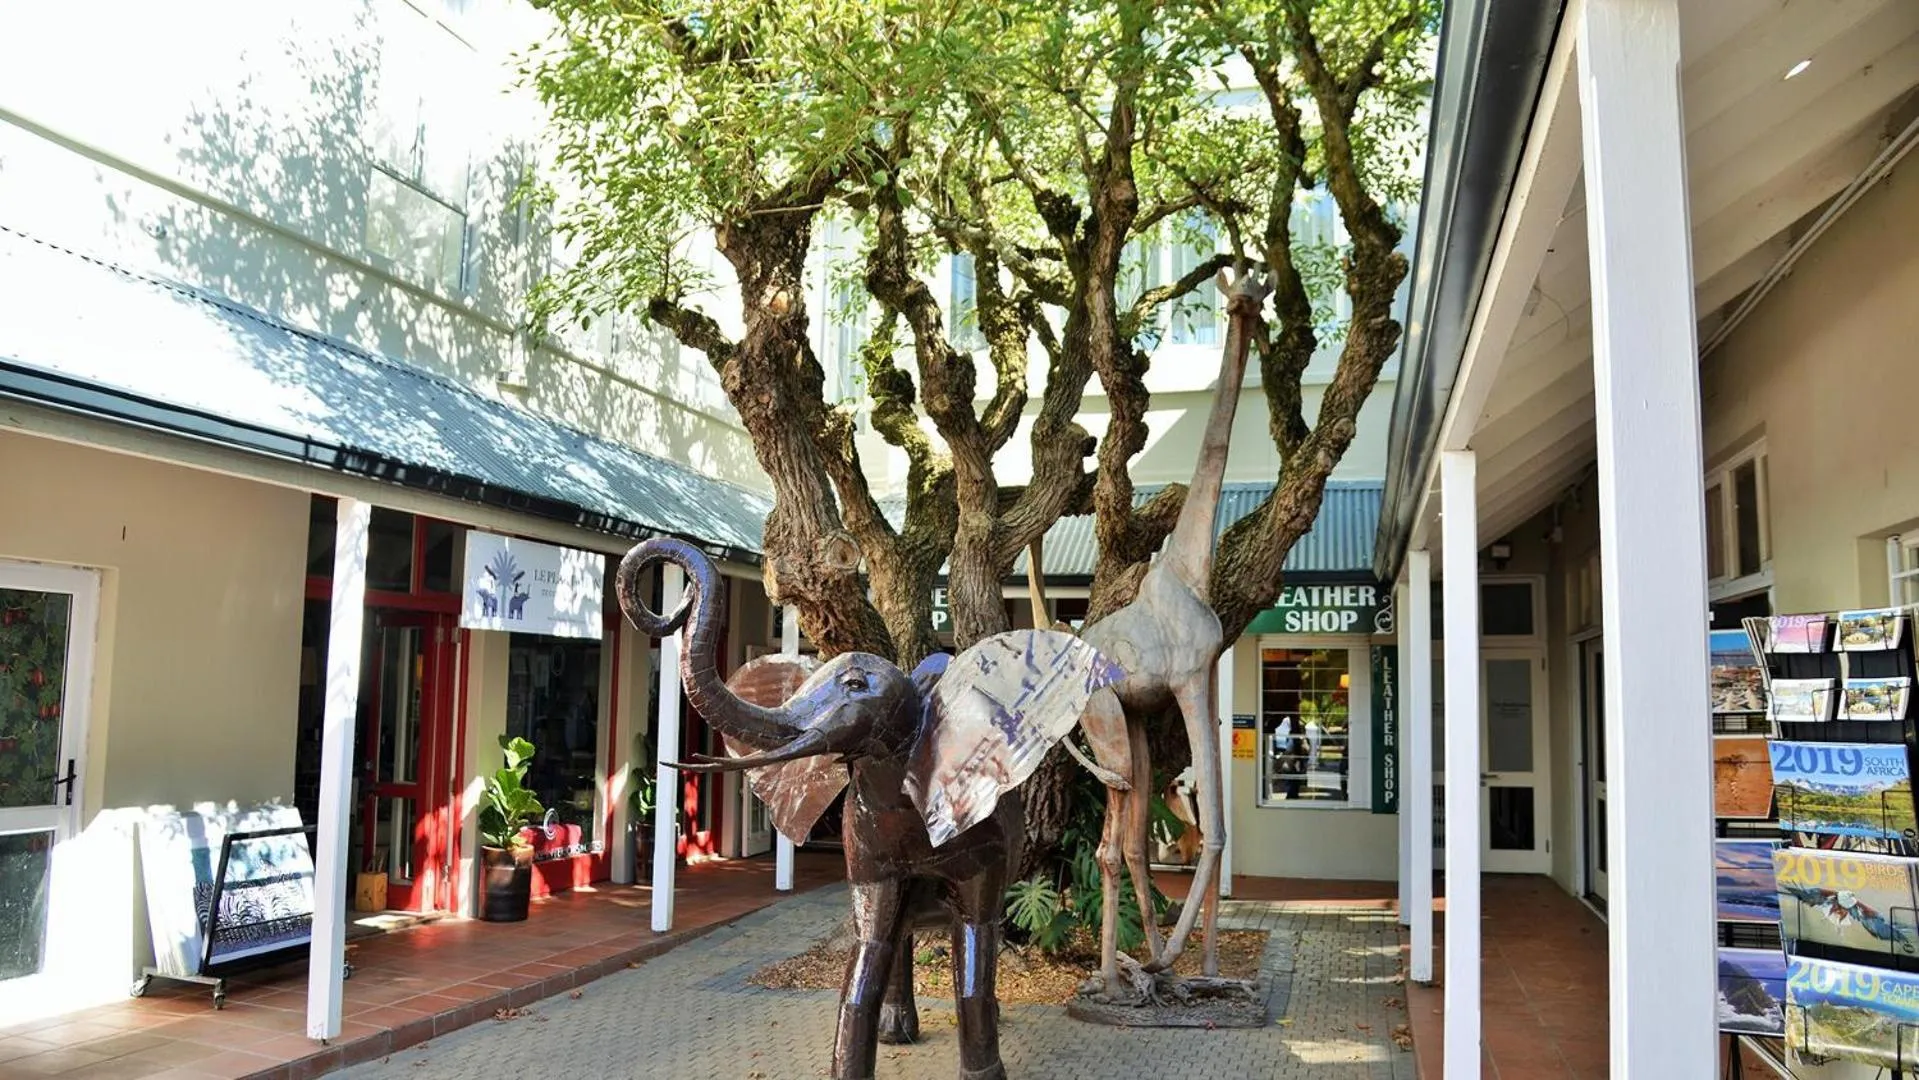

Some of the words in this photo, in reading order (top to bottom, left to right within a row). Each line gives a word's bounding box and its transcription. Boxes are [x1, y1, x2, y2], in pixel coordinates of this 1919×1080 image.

[1274, 585, 1377, 607] EATHER
[1285, 610, 1358, 632] SHOP
[1383, 656, 1395, 746] LEATHER
[1772, 745, 1863, 776] 2019
[1864, 756, 1905, 768] SOUTH
[1866, 766, 1906, 777] AFRICA
[1384, 753, 1395, 803] SHOP
[1775, 853, 1866, 889] 2019
[1790, 960, 1880, 1001] 2019
